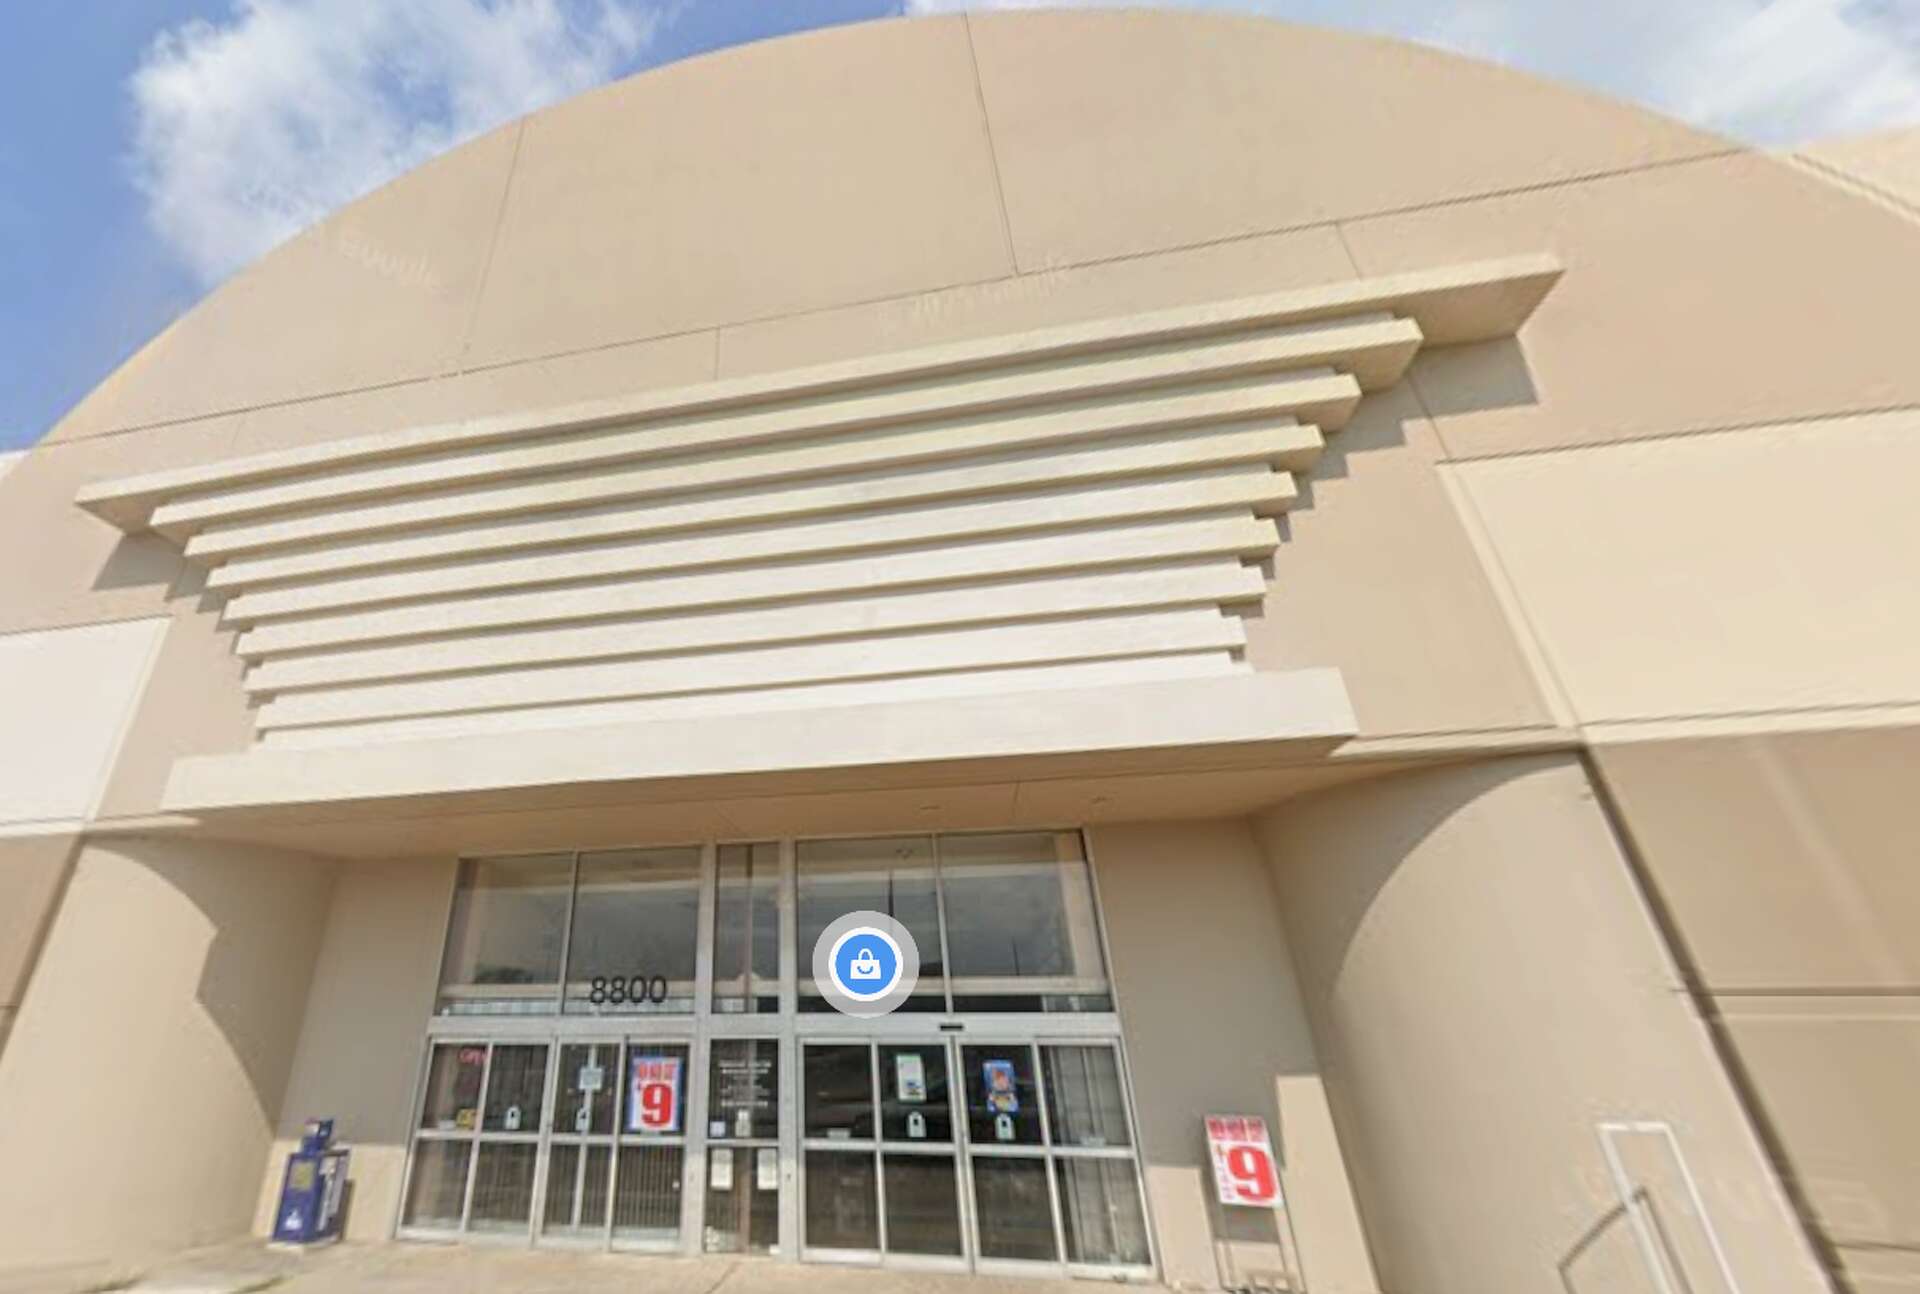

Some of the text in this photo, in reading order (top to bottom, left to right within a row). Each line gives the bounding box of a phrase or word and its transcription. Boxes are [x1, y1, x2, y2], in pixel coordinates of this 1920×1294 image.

[590, 975, 667, 1004] 8800
[642, 1083, 672, 1126] 9
[1226, 1146, 1276, 1201] 9
